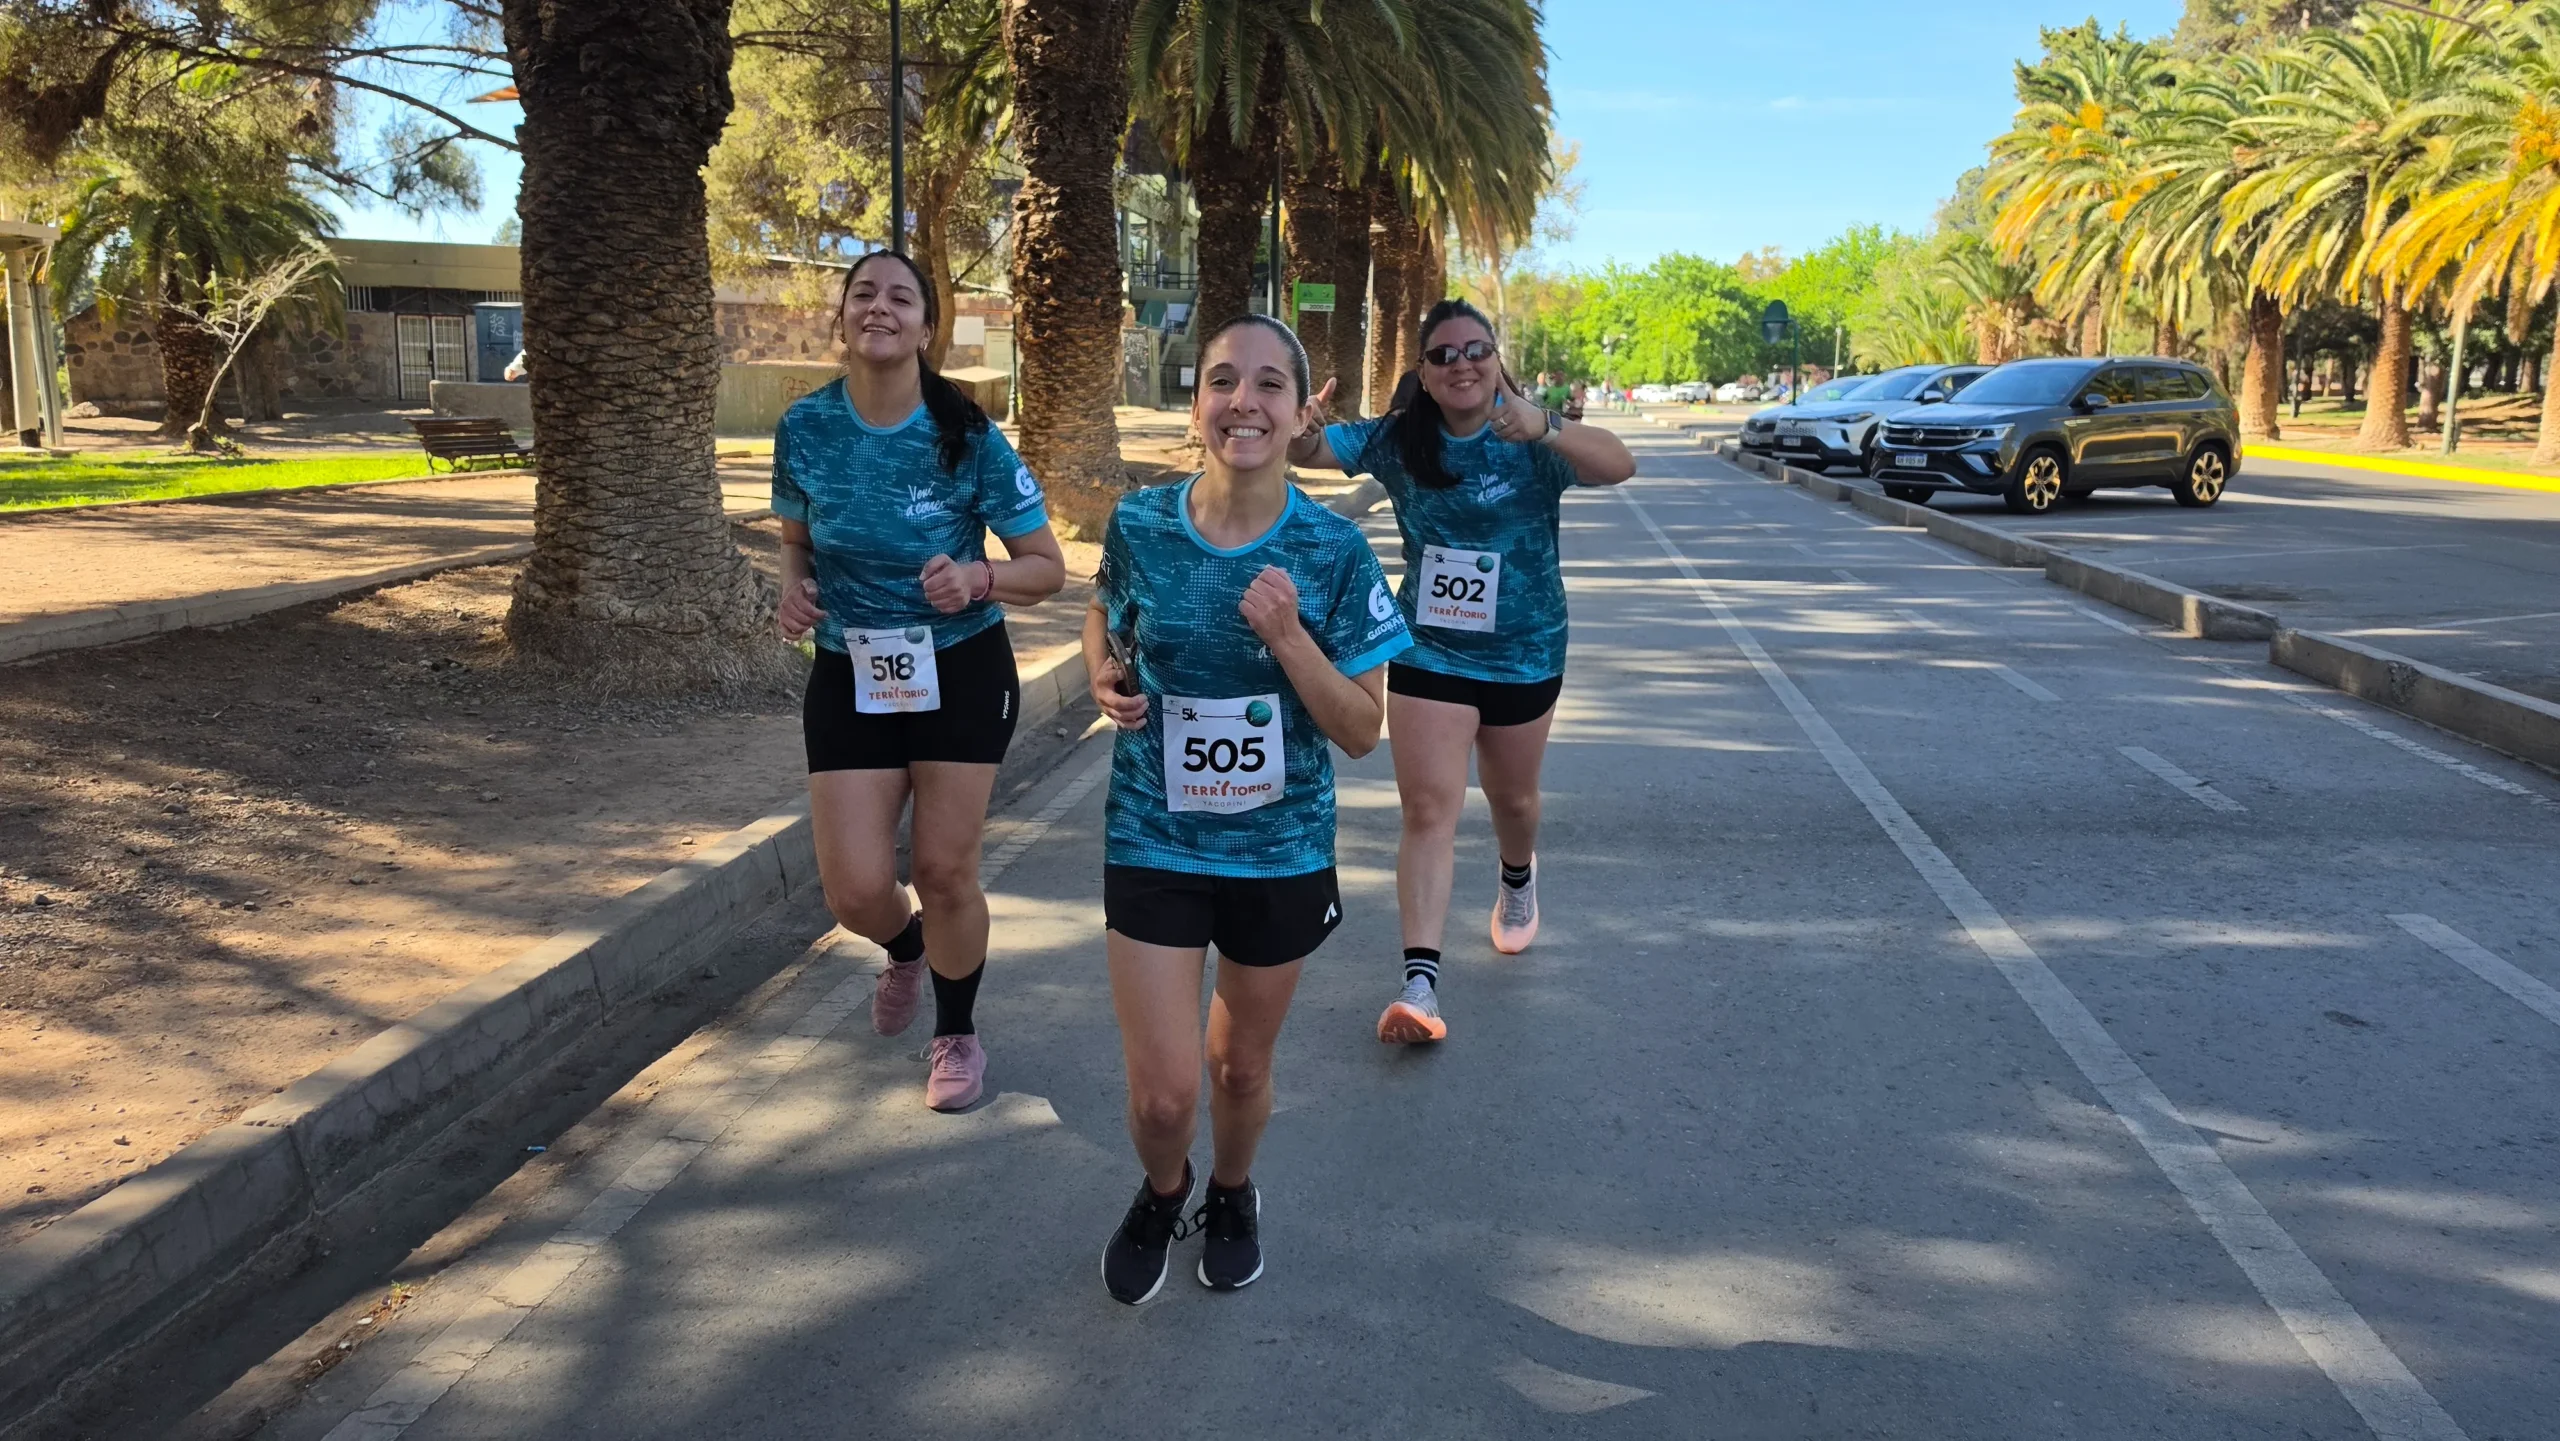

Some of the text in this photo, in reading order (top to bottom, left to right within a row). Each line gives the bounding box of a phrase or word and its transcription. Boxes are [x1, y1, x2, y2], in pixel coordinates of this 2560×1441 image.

[1434, 553, 1445, 565] 5k
[1430, 573, 1486, 603] 502
[858, 634, 871, 645] 5k
[870, 652, 916, 682] 518
[1182, 707, 1198, 722] 5k
[1182, 736, 1266, 774] 505
